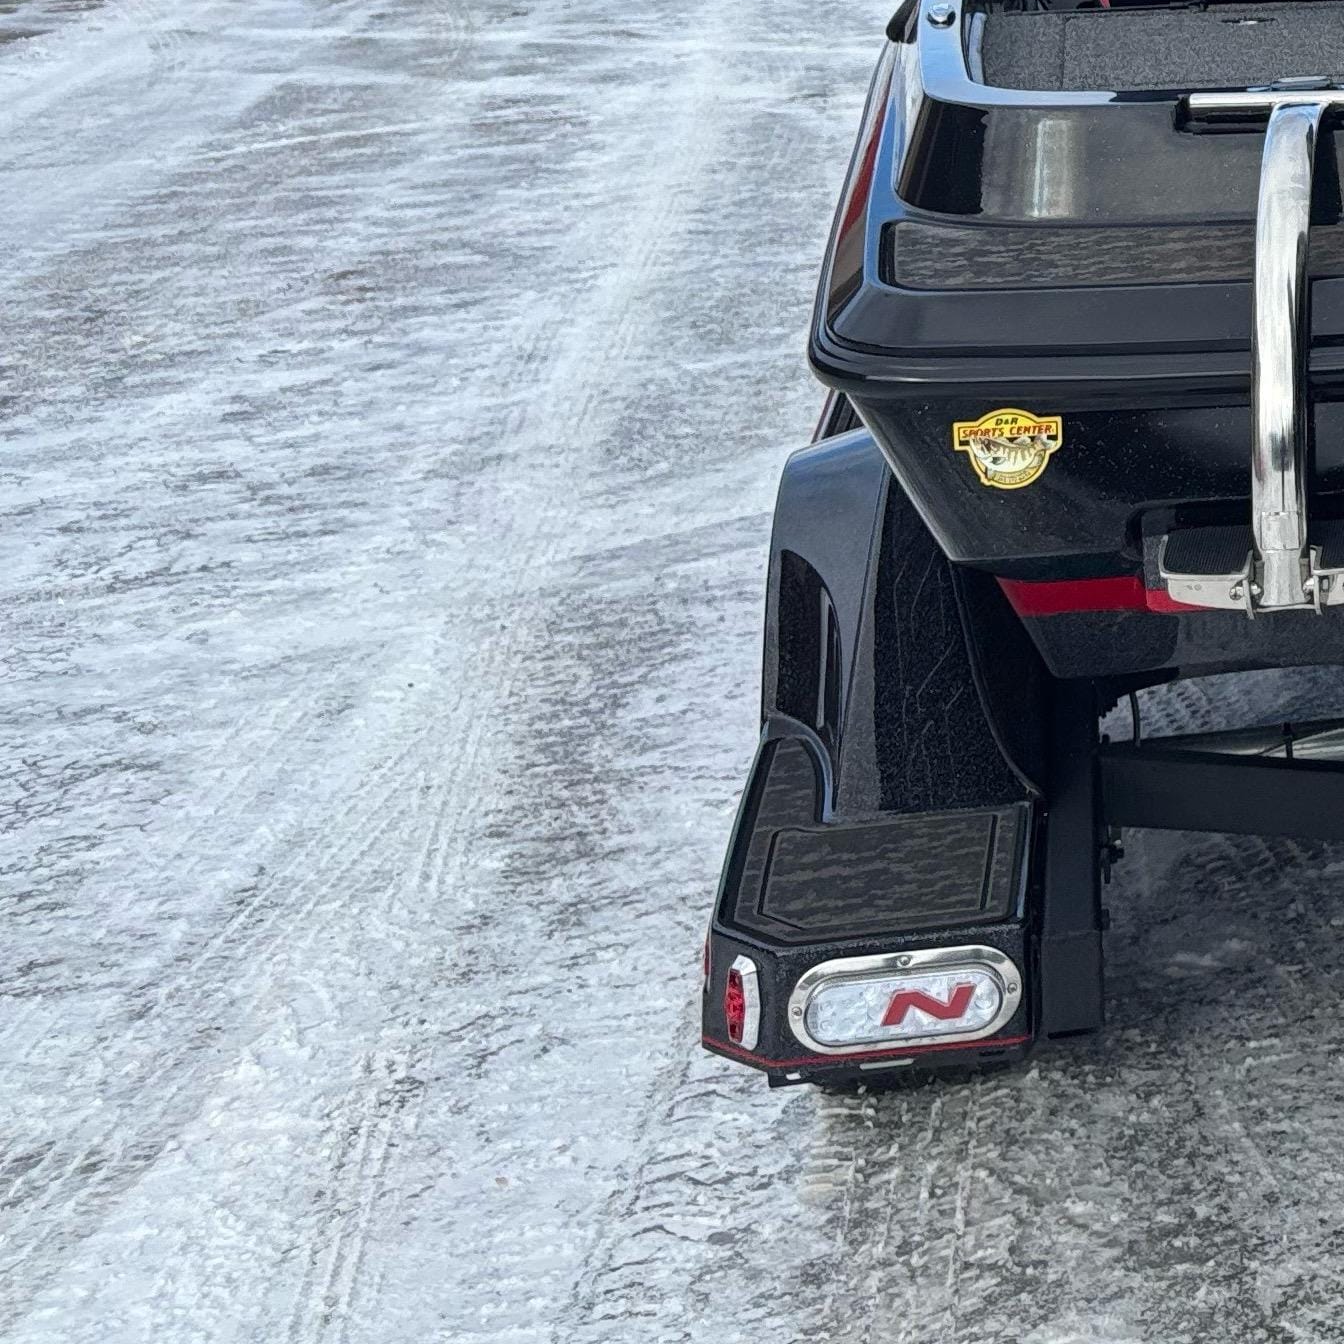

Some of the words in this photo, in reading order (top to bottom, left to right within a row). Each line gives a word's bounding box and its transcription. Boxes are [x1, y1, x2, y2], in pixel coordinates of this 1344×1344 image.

[995, 417, 1019, 426] D&R
[961, 427, 1005, 439] SPORTS
[1009, 424, 1052, 436] CENTER
